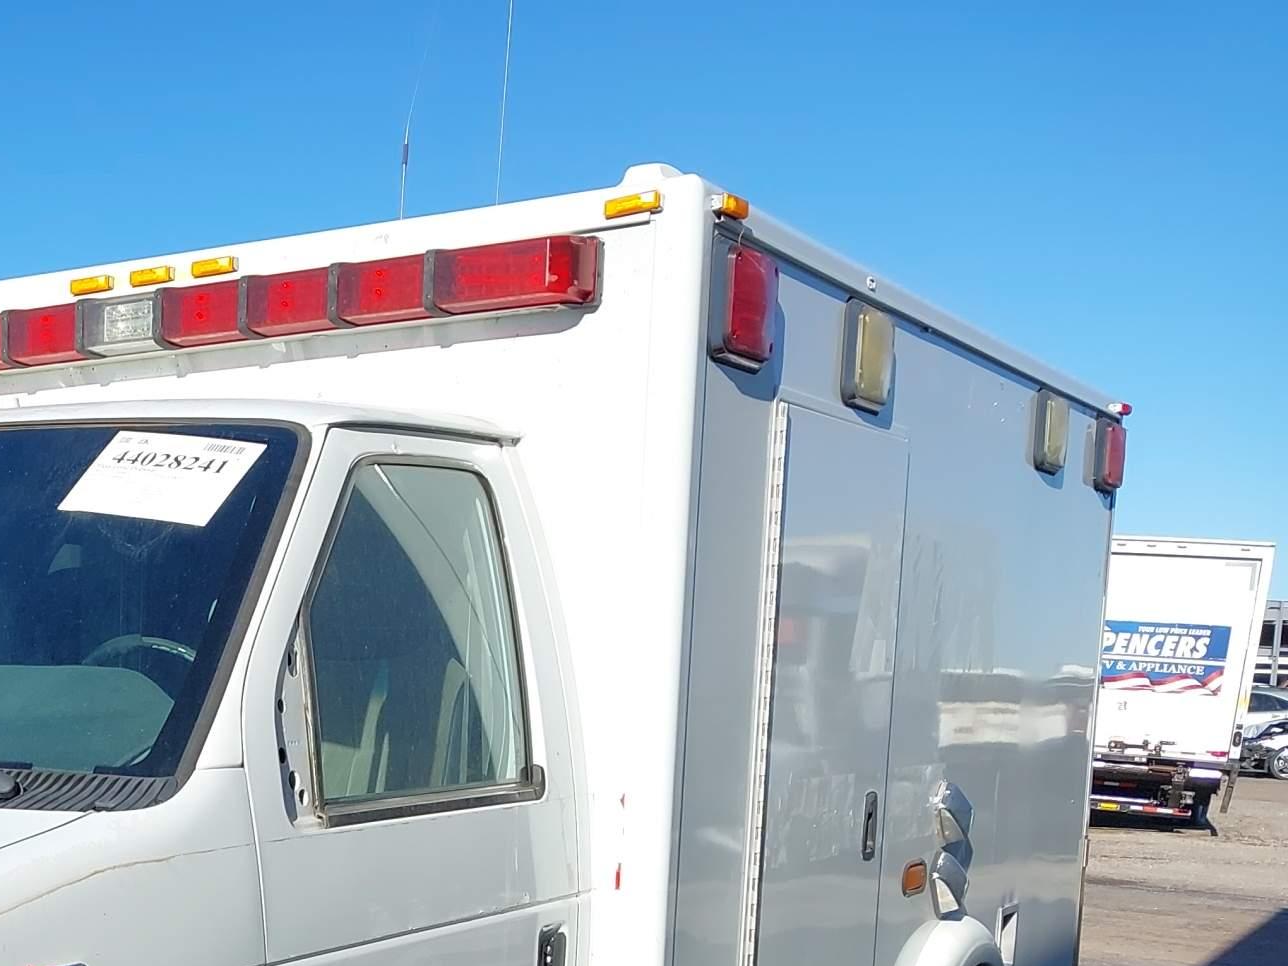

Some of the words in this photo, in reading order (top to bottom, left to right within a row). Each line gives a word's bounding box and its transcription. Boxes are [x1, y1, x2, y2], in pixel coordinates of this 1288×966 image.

[112, 450, 228, 475] 44028241
[1103, 631, 1210, 660] PENCERS
[1116, 661, 1127, 670] &
[1127, 661, 1205, 676] APPLIANCE
